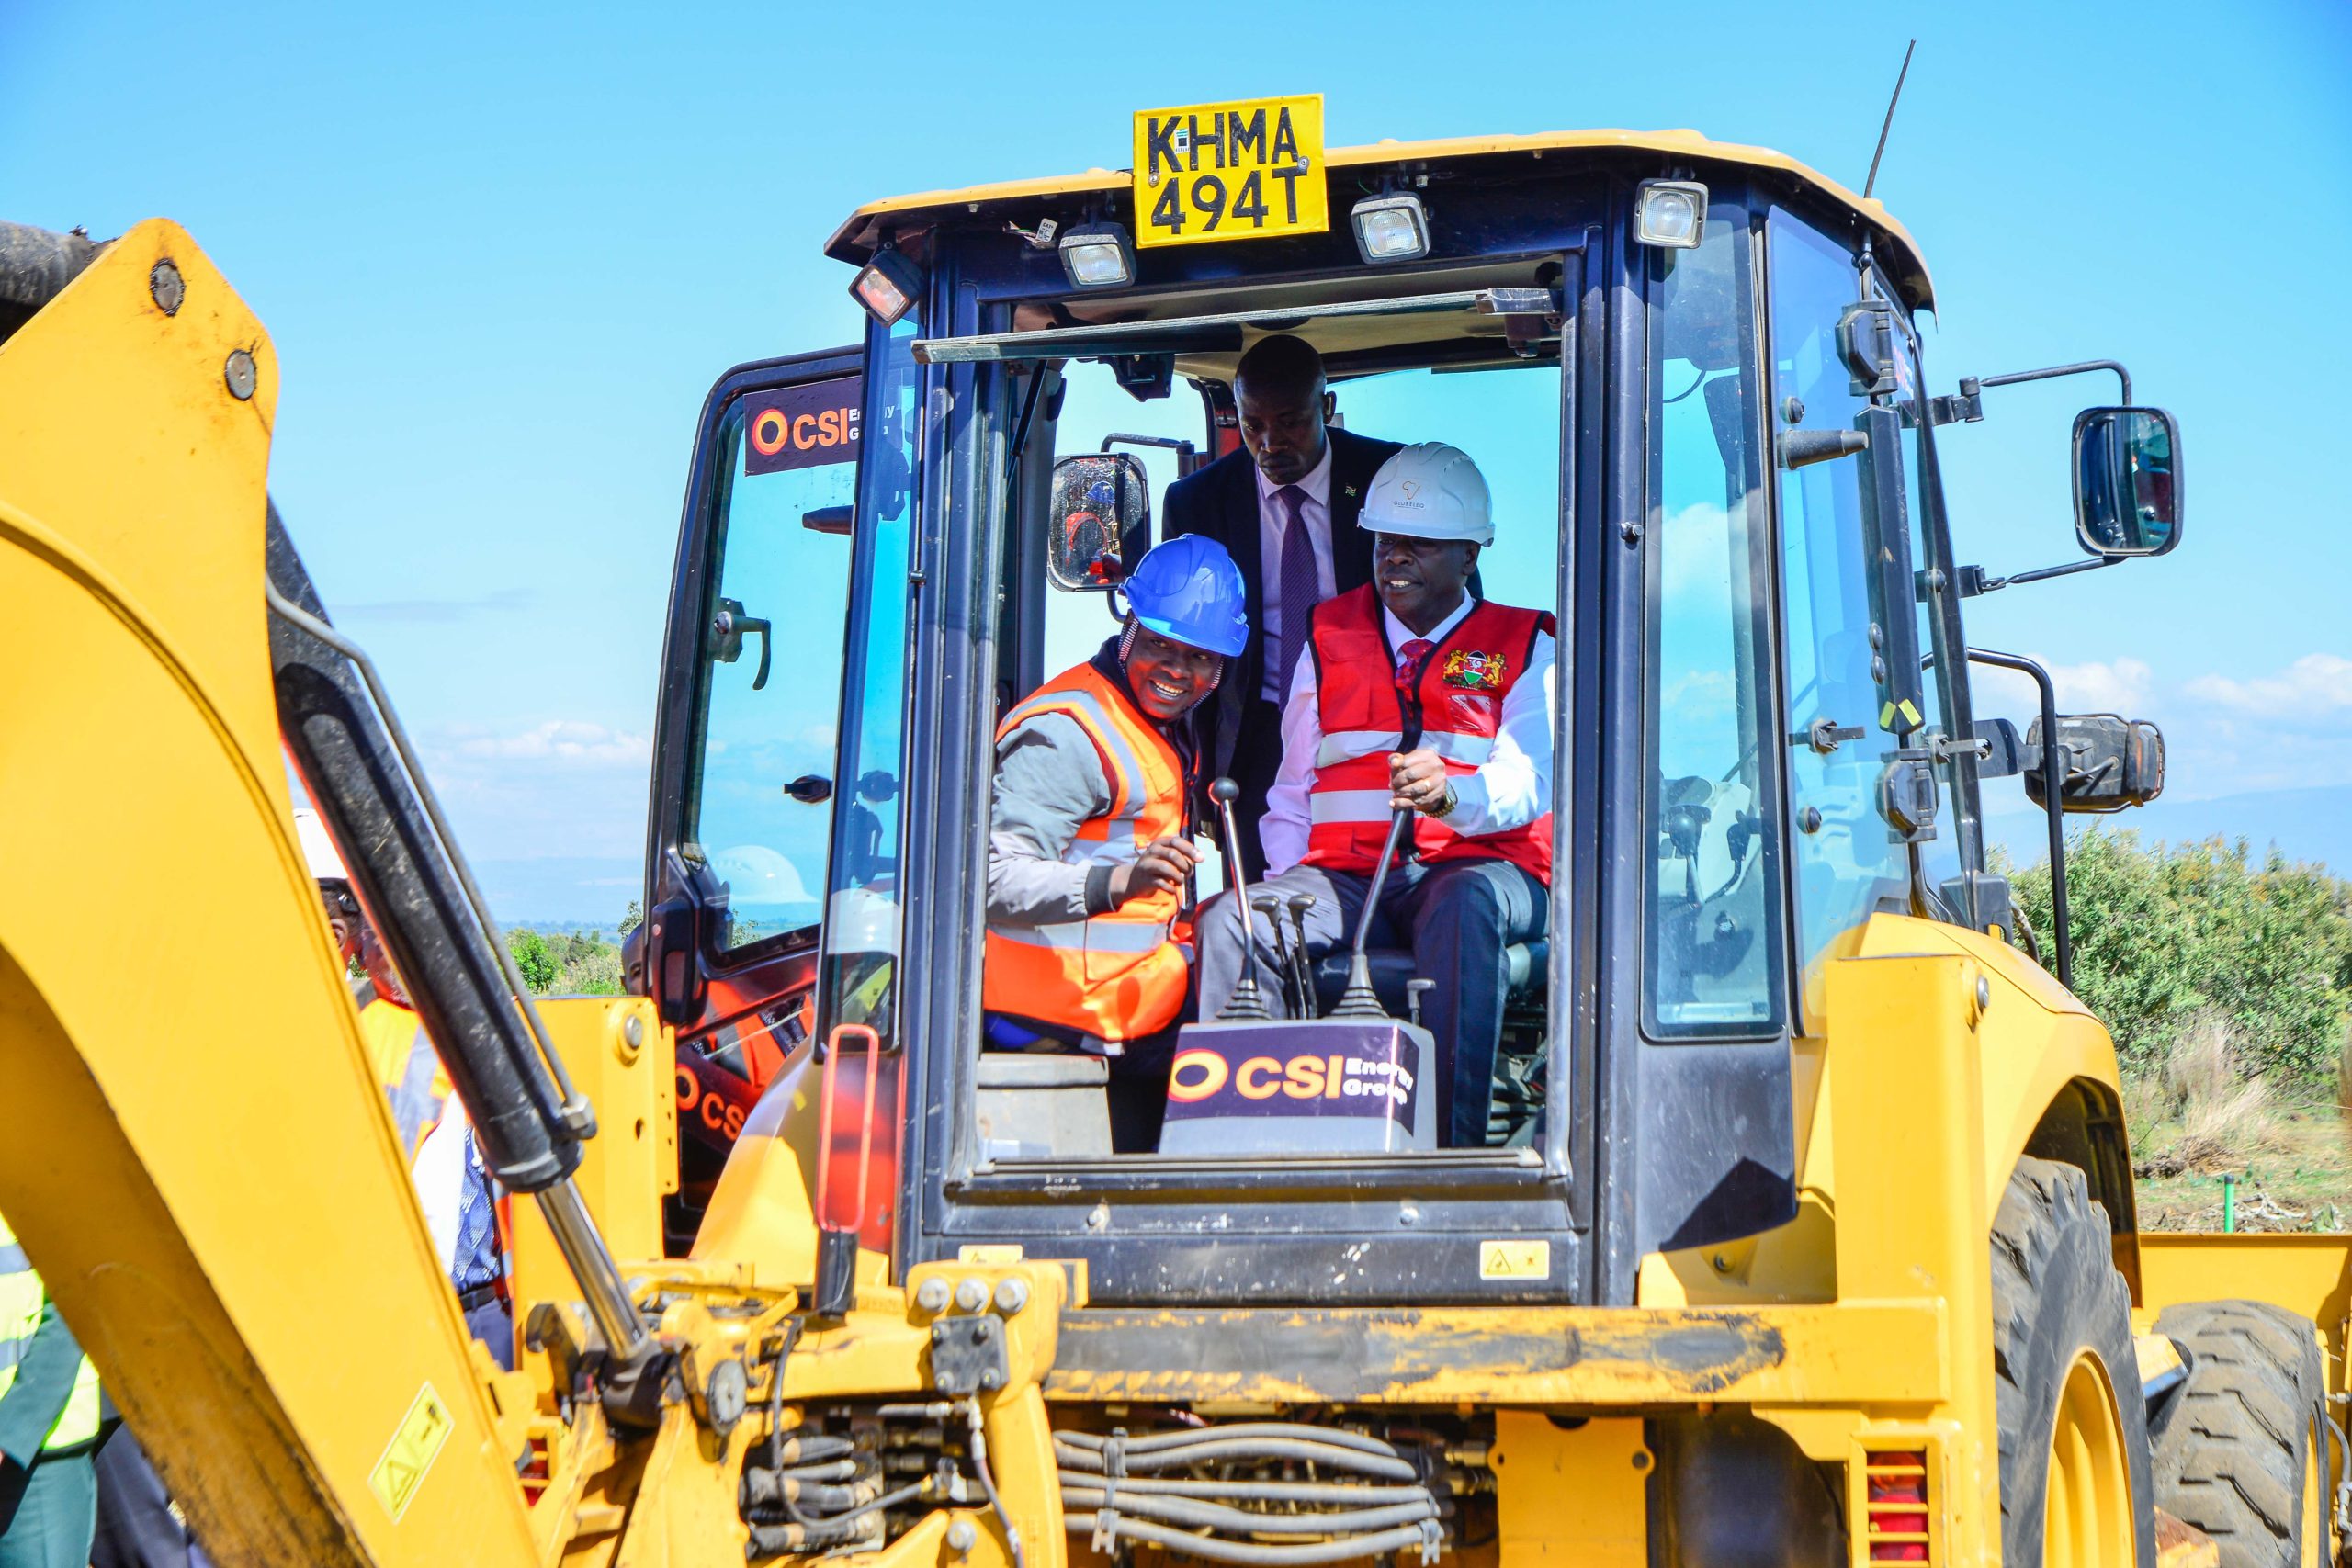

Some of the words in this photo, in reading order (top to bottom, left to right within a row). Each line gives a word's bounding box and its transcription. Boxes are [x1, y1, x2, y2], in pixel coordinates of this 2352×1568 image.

[1148, 107, 1300, 174] KHMA
[1151, 166, 1308, 235] 494T
[1343, 1078, 1408, 1105] Group
[1345, 1058, 1414, 1090] Energy
